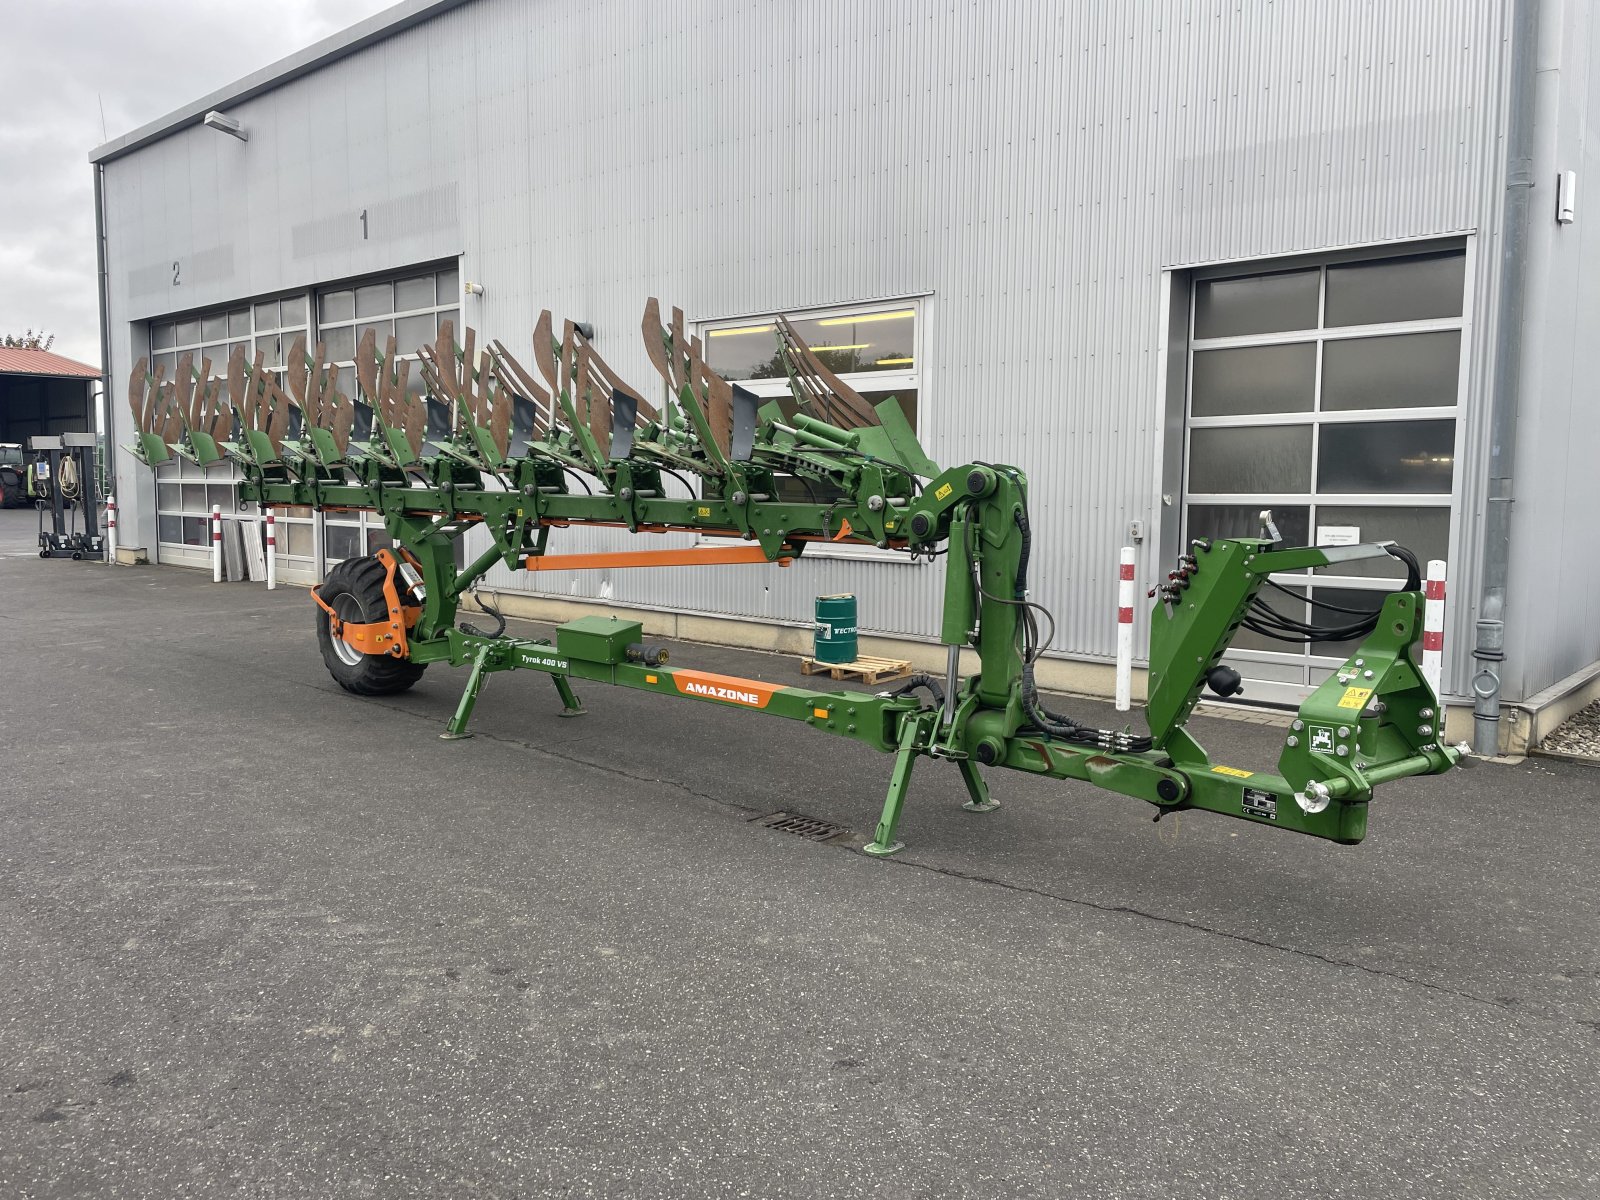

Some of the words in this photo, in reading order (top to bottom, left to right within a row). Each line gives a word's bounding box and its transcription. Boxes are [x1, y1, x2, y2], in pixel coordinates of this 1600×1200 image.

[360, 209, 368, 240] 1
[173, 261, 181, 286] 2
[521, 654, 541, 664] Tyrok
[542, 658, 556, 667] 400
[557, 660, 568, 669] VS
[685, 682, 759, 705] AMAZONE
